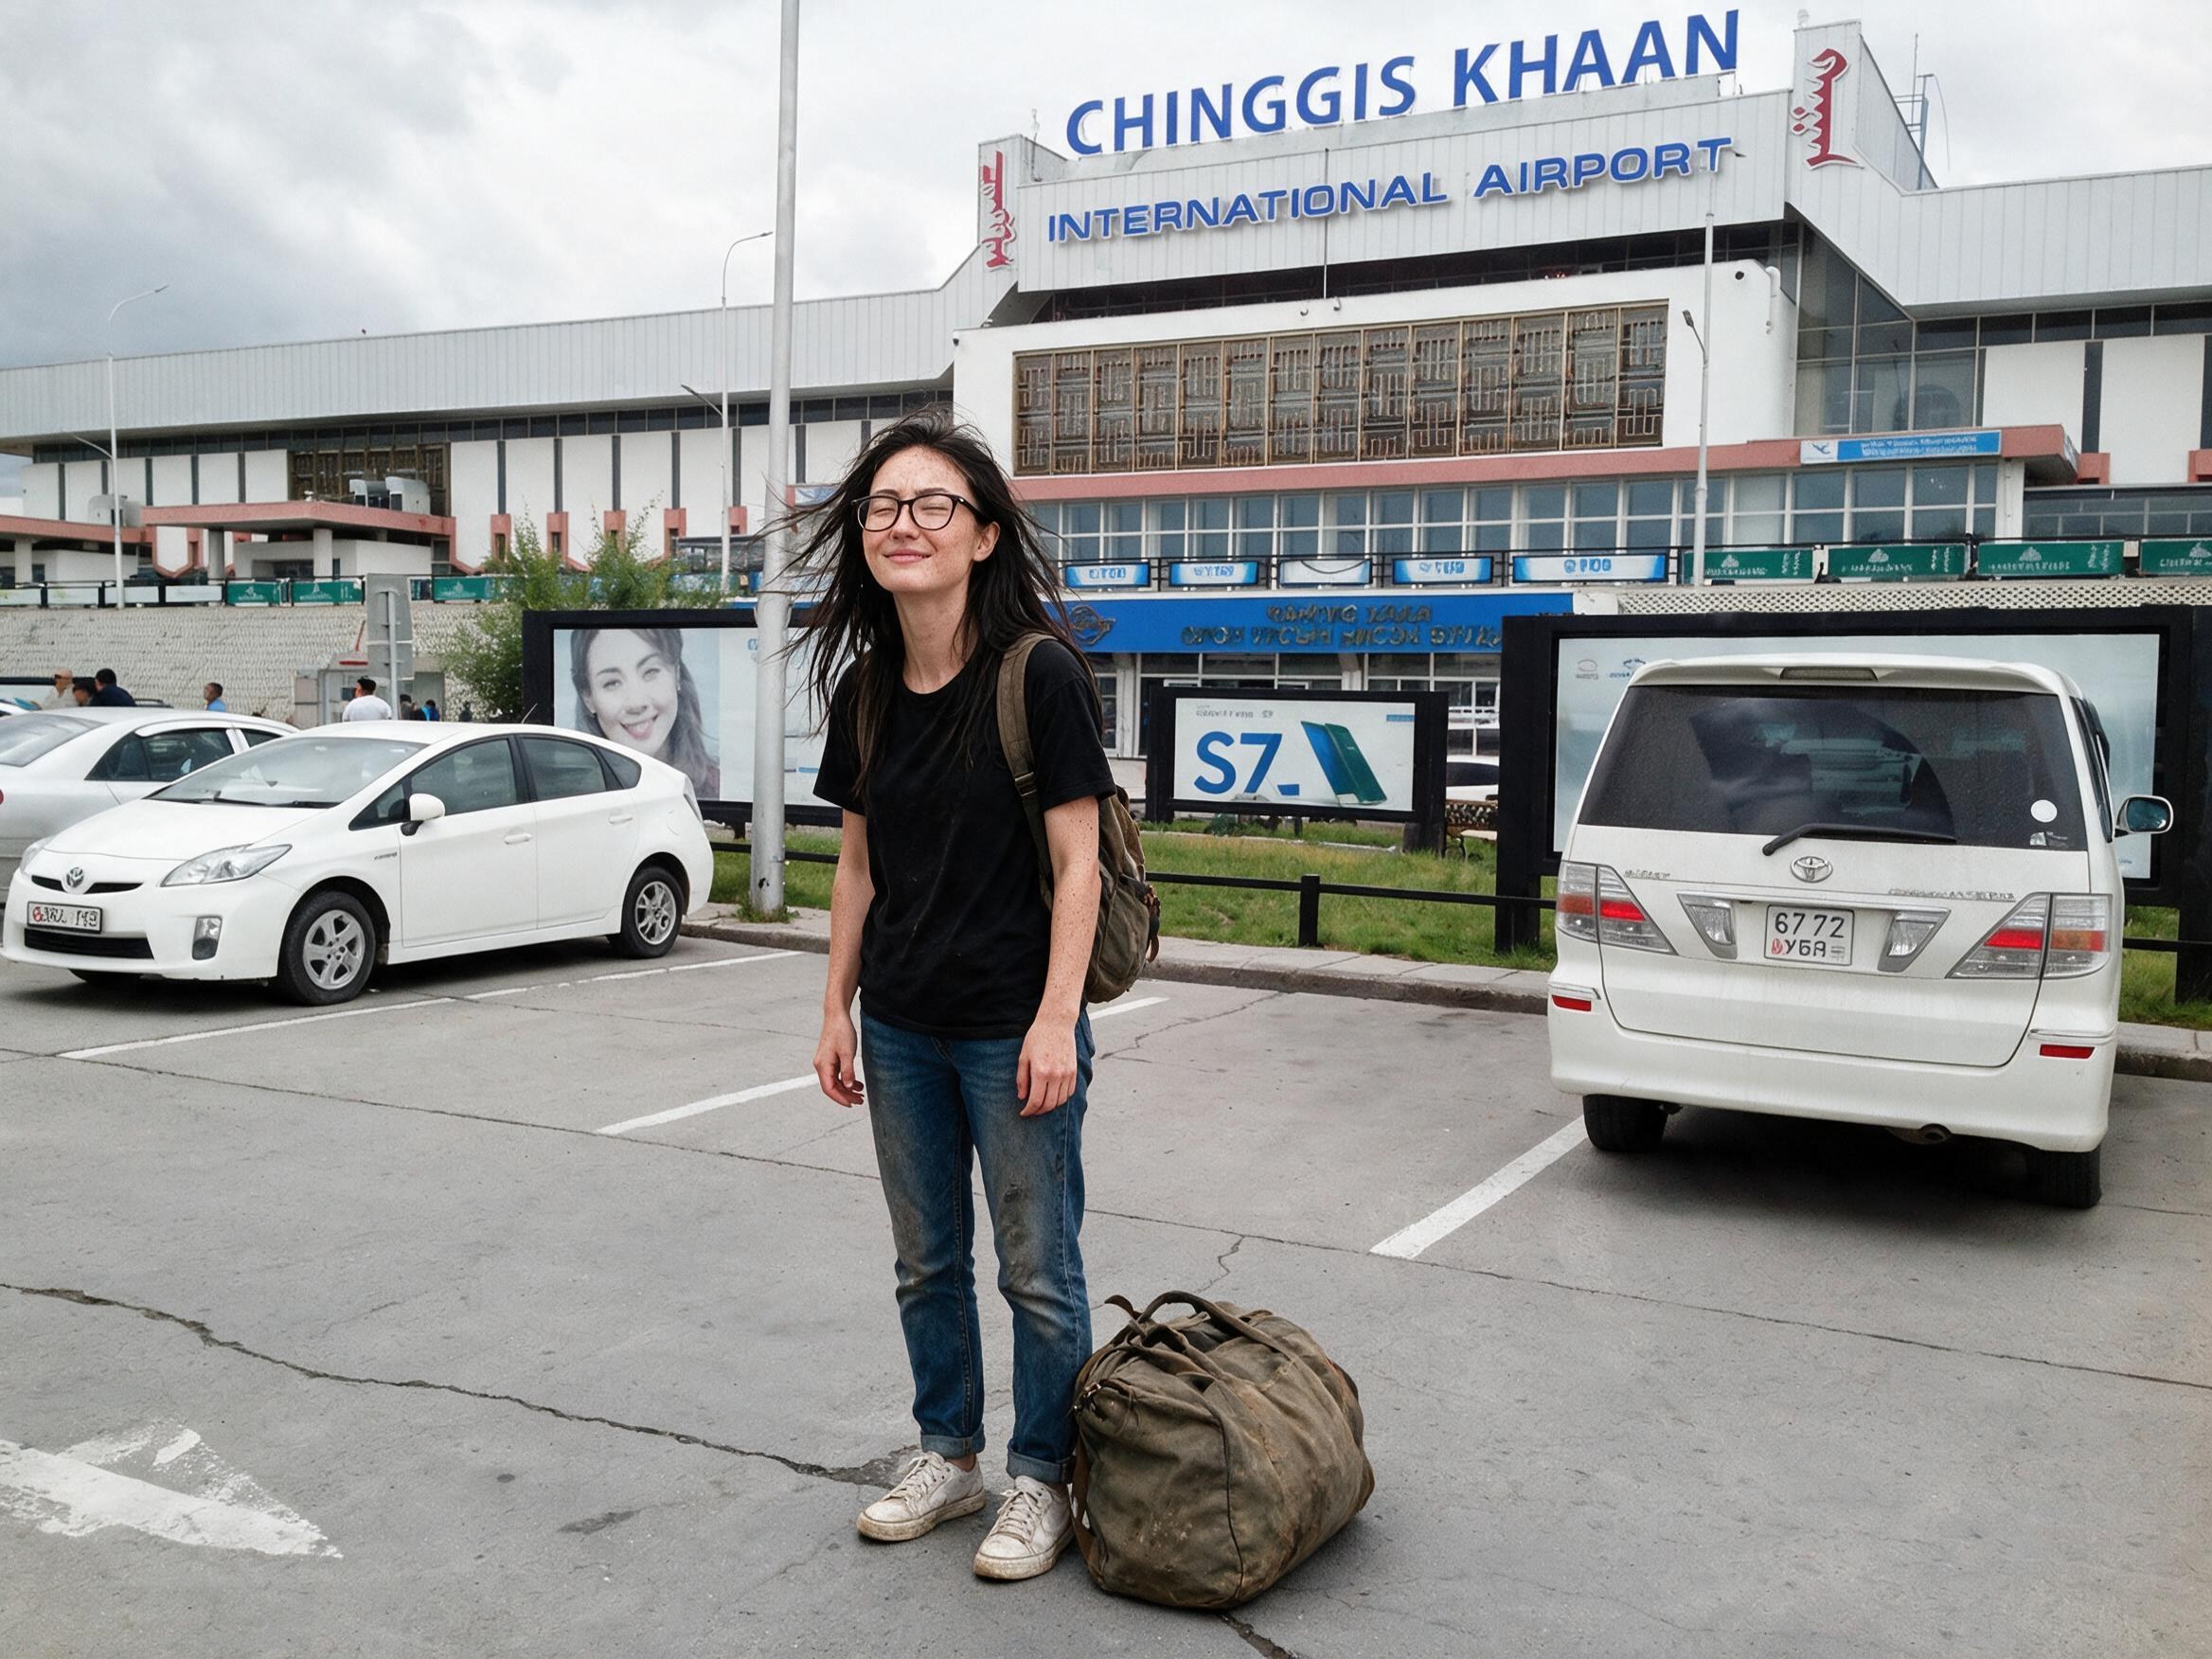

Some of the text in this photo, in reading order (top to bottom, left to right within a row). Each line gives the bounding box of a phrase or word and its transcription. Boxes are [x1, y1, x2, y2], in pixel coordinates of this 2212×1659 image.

[1066, 9, 1739, 155] CHINGGIS KHAAN
[1048, 137, 1732, 242] INTERNATIONAL AIRPORT
